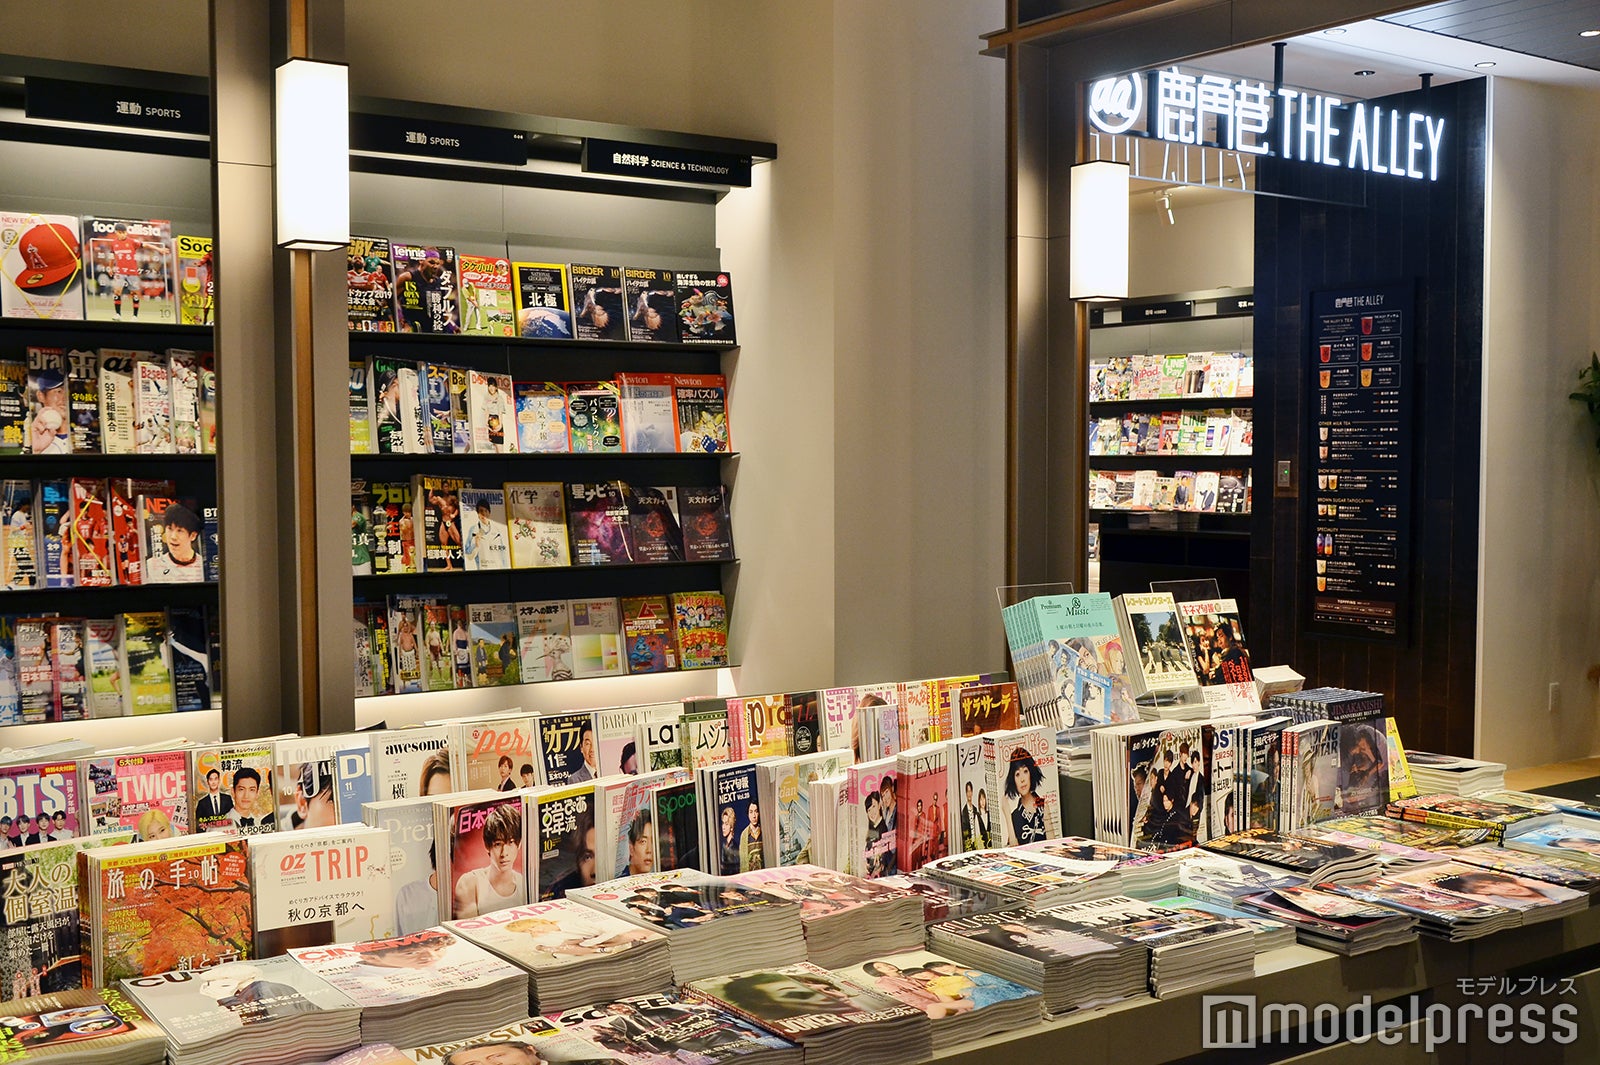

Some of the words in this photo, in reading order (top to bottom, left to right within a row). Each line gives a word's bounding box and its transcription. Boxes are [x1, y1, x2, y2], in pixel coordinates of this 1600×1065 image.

[116, 101, 142, 116] 運動
[145, 107, 181, 118] SPORTS
[1158, 67, 1271, 155] 鹿角巷
[1278, 89, 1341, 166] THE
[1348, 103, 1445, 181] ALLEY
[405, 132, 427, 145] 運動
[429, 137, 460, 148] SPORTS
[612, 152, 650, 167] 自然科学
[651, 159, 680, 170] SCIENCE
[687, 164, 729, 175] TECHNOLOGY
[393, 246, 426, 259] Tennis
[463, 261, 494, 273] タケ小山
[572, 265, 604, 276] BIRDER
[610, 269, 620, 278] 10
[625, 268, 656, 279] BIRDER
[662, 272, 672, 281] 10
[405, 281, 417, 292] US
[403, 291, 420, 299] OPEN
[440, 270, 455, 327] ダブルス
[529, 292, 558, 307] 北極
[1353, 296, 1365, 307] THE
[1365, 294, 1385, 306] ALLEY
[620, 375, 649, 384] Newton
[674, 376, 702, 386] Newton
[676, 388, 719, 400] 確率パズル
[104, 382, 119, 433] 93年組集合
[536, 400, 549, 441] 天気予報
[589, 398, 601, 446] パラドックス
[461, 490, 504, 505] SWIMMING
[510, 489, 539, 505] 化学
[571, 484, 606, 502] 星ナビ
[687, 495, 719, 505] 天文ガイド
[471, 610, 494, 623] 武道
[519, 605, 560, 616] 大学への数学
[1066, 606, 1089, 616] Music
[962, 692, 1012, 721] サラサーテ
[1331, 703, 1346, 716] JIN
[1346, 699, 1383, 713] AKANISHI
[220, 759, 243, 772] 韓流
[117, 770, 186, 803] TWICE
[718, 776, 749, 794] キネマ旬報
[0, 774, 66, 821] BTS
[718, 791, 737, 805] NEXT
[310, 845, 369, 882] TRIP
[2, 863, 72, 898] 大人の
[107, 854, 218, 900] 旅の手帖
[187, 869, 200, 879] 10
[3, 884, 79, 925] 個室温
[287, 901, 365, 923] 秋の京都へ
[7, 917, 71, 939] 部屋に露天風呂が
[297, 930, 451, 961] CINEMA
[778, 1011, 850, 1034] JOKER
